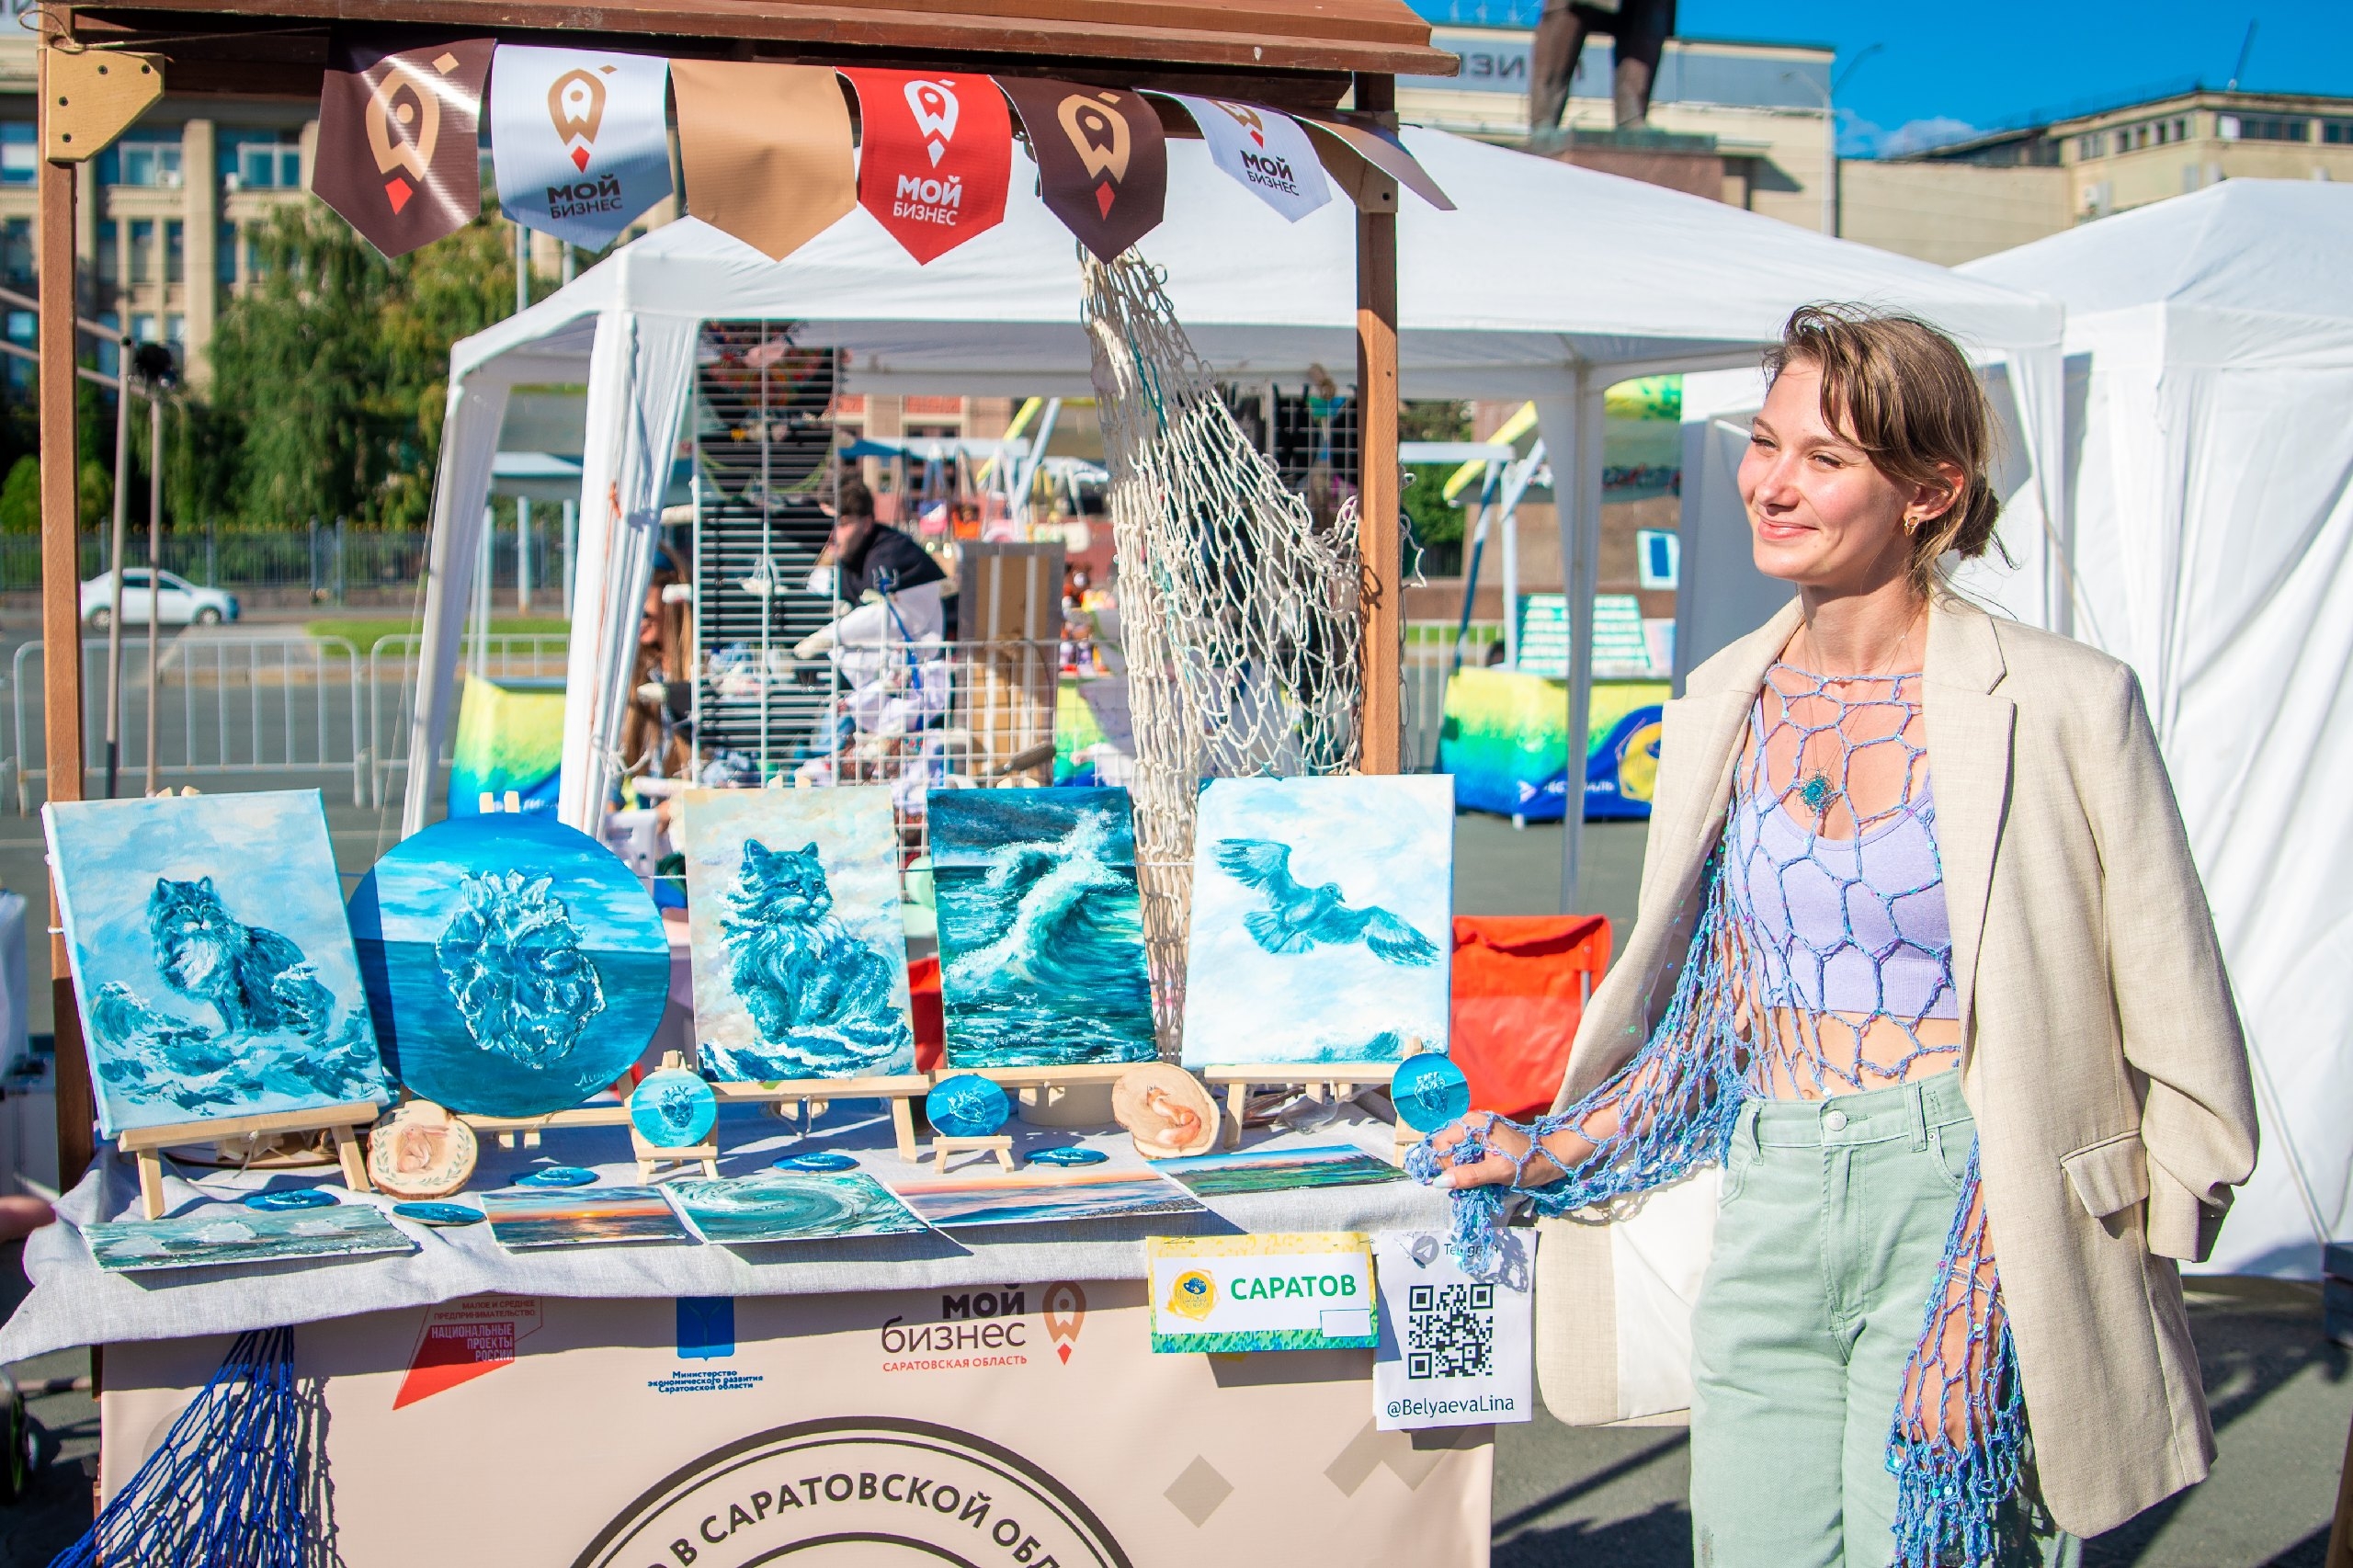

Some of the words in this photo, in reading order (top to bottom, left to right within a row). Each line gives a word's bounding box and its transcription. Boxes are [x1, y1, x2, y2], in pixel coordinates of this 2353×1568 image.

[1240, 150, 1294, 182] МОЙ
[547, 174, 620, 204] МОЙ
[896, 174, 962, 208] МОЙ
[1246, 170, 1300, 196] БИЗНЕС
[551, 198, 623, 220] БИЗНЕС
[892, 200, 958, 226] БИЗНЕС
[1231, 1274, 1357, 1301] САРАТОВ
[434, 1310, 536, 1321] ПРЕДПРИНИМАТЕЛЬСТВО
[462, 1301, 490, 1310] МАЛОЕ
[499, 1300, 535, 1308] СРЕДНЕЕ
[431, 1324, 513, 1339] НАЦИОНАЛЬНЫЕ
[881, 1315, 1027, 1353] бизнес
[467, 1337, 513, 1350] ПРОЕКТЫ
[475, 1349, 514, 1361] РОССИИ
[882, 1358, 970, 1372] САРАТОВСКАЯ
[972, 1355, 1028, 1367] ОБЛАСТЬ
[647, 1378, 722, 1387] экономического
[723, 1375, 764, 1385] развития
[672, 1370, 737, 1382] Министерство
[658, 1383, 716, 1394] Саратовской
[717, 1382, 754, 1391] области
[1387, 1394, 1515, 1418] @BelyaevaLina
[669, 1538, 698, 1567] В
[699, 1472, 993, 1544] САРАТОВСКОЙ
